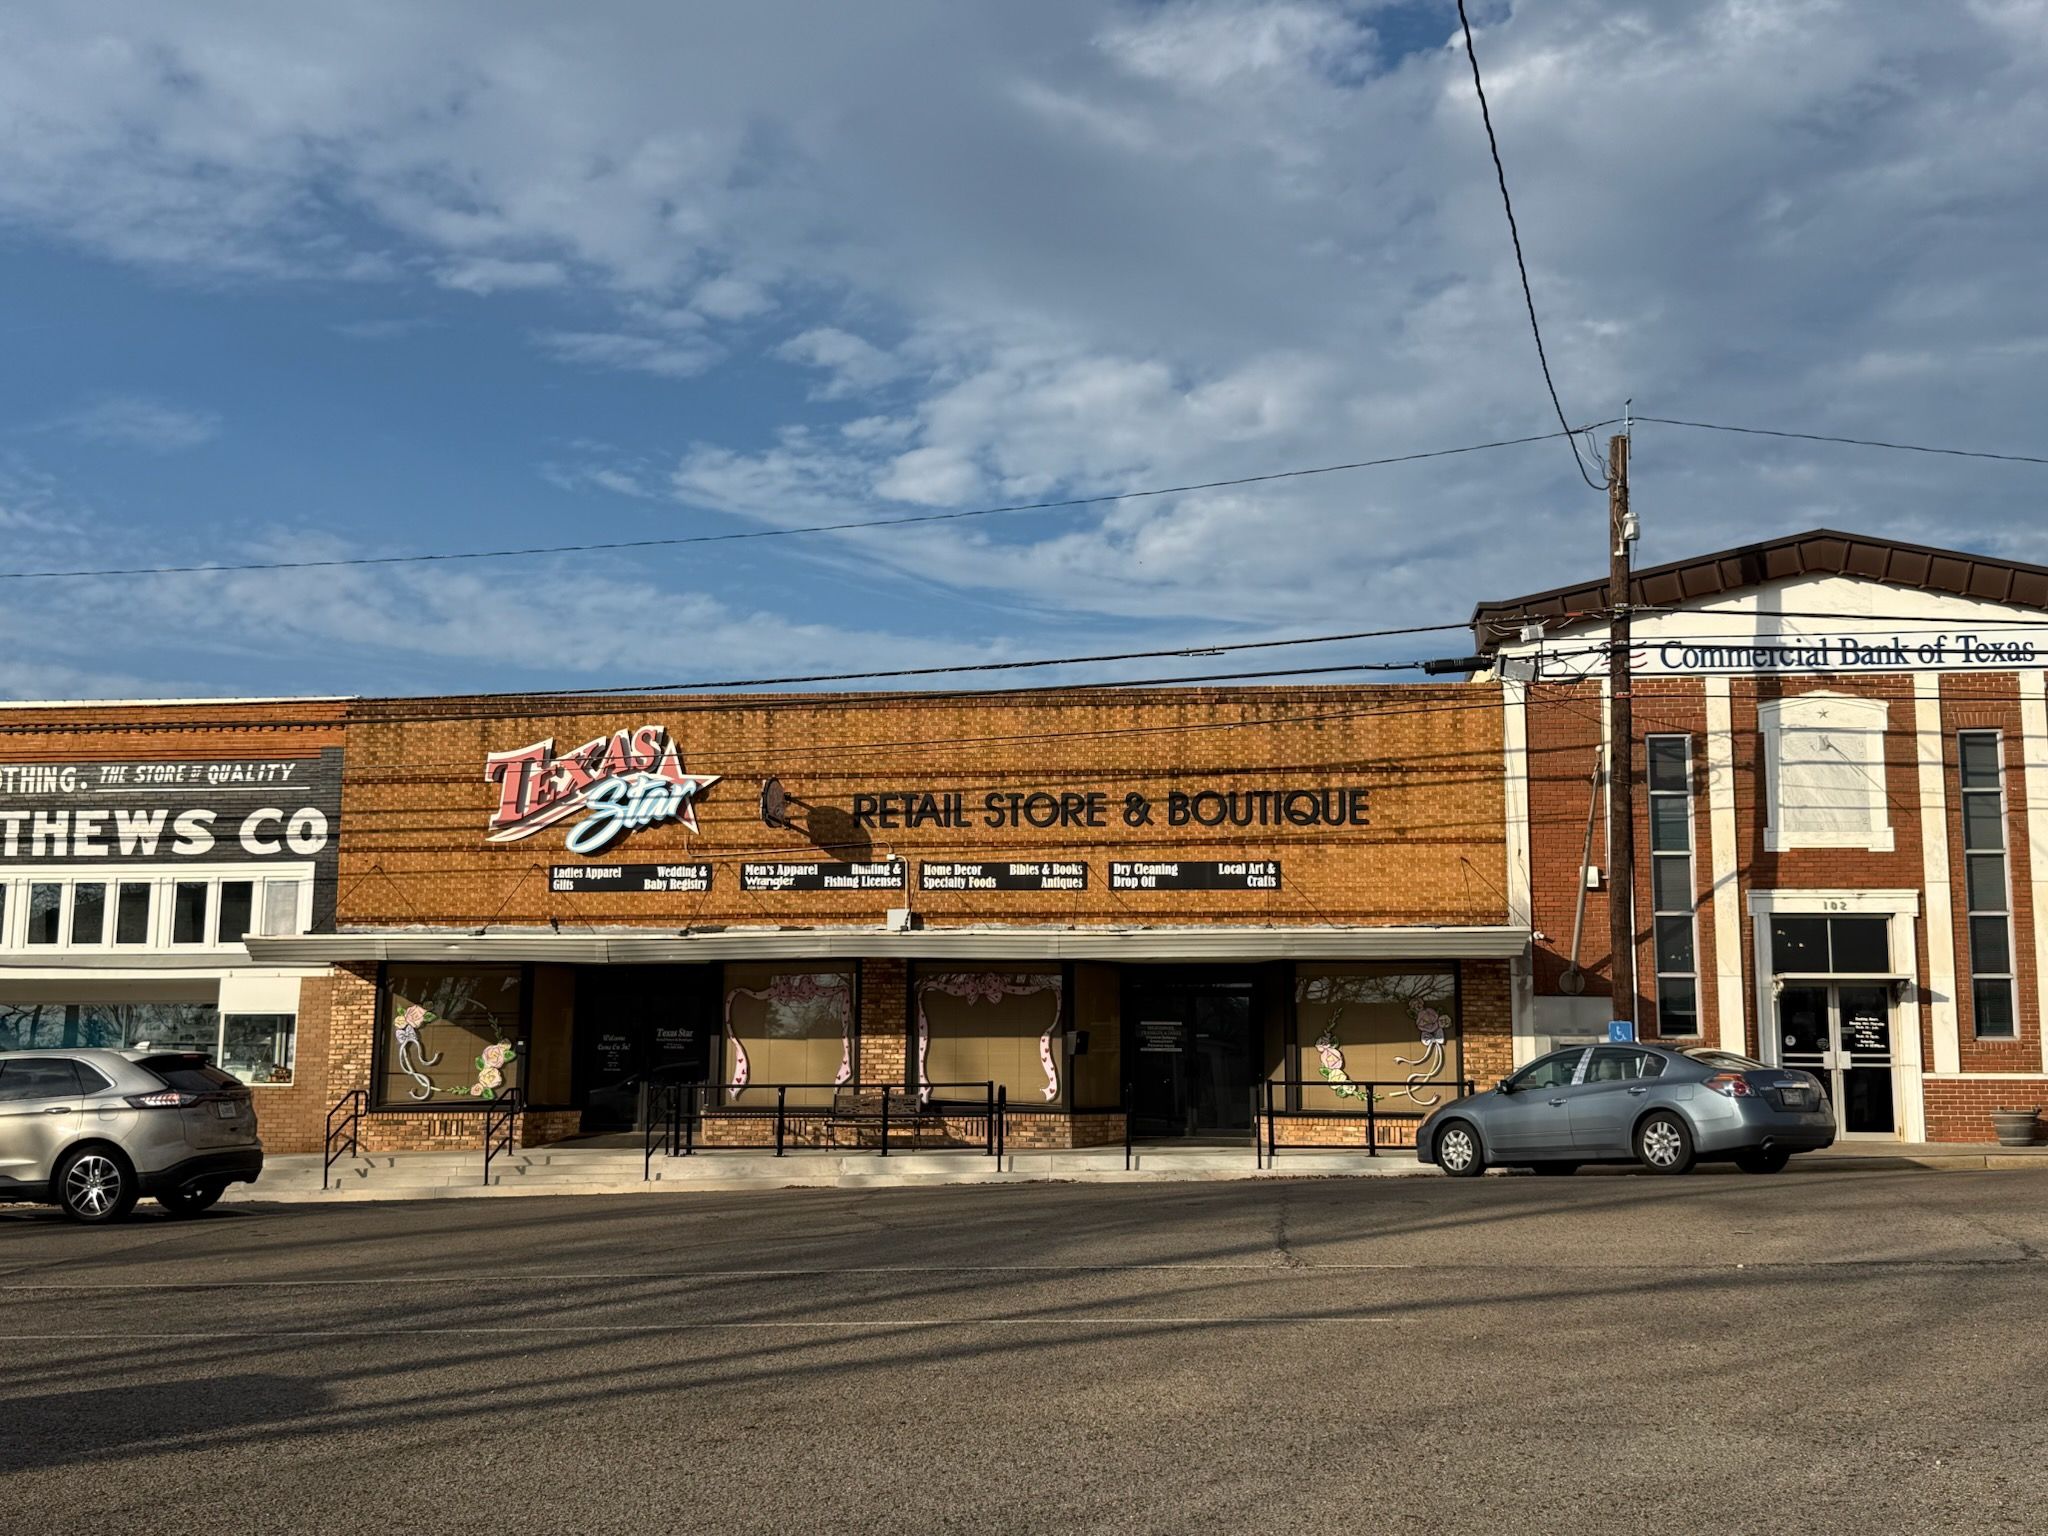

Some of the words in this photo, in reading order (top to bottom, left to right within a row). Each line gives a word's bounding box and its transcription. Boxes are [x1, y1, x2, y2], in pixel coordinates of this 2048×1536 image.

[1660, 637, 1830, 669] Commercial
[1838, 636, 1911, 666] Bank
[1917, 635, 1948, 664] of
[1956, 635, 2036, 663] Texas
[100, 766, 128, 784] THE
[134, 764, 187, 783] STORE
[207, 763, 296, 785] QUALITY
[565, 776, 697, 853] Star
[852, 793, 972, 829] RETAIL
[984, 791, 1107, 828] STORE
[1122, 791, 1154, 827] &
[1168, 790, 1370, 826] BOUTIQUE
[238, 806, 328, 855] CO
[553, 867, 583, 879] Ladies
[585, 866, 622, 880] Apparel
[657, 866, 697, 879] Wedding
[699, 866, 708, 878] &
[745, 864, 775, 876] Men's
[777, 864, 819, 878] Apparel
[851, 863, 890, 876] Hunting
[892, 863, 902, 875] &
[923, 864, 952, 876] Home
[954, 864, 983, 876] Decor
[1009, 863, 1039, 876] Bibles
[1041, 863, 1051, 875] &
[1052, 863, 1083, 875] Books
[1113, 863, 1131, 876] Dry
[1134, 863, 1179, 876] Cleaning
[1218, 863, 1246, 875] Local
[1248, 863, 1264, 875] Art
[1267, 863, 1276, 875] &
[553, 879, 574, 891] Gifts
[644, 879, 668, 892] Baby
[670, 879, 708, 892] Registry
[745, 876, 796, 890] Wrangler
[824, 876, 859, 888] Fishing
[861, 876, 902, 888] Licenses
[923, 876, 966, 889] Specialty
[968, 876, 997, 888] Foods
[1041, 876, 1083, 889] Antiques
[1113, 875, 1139, 888] Drop
[1141, 875, 1156, 888] Off
[1247, 875, 1277, 888] Crafts
[1823, 901, 1848, 911] 102
[656, 1028, 677, 1037] Texas
[678, 1028, 694, 1037] Star
